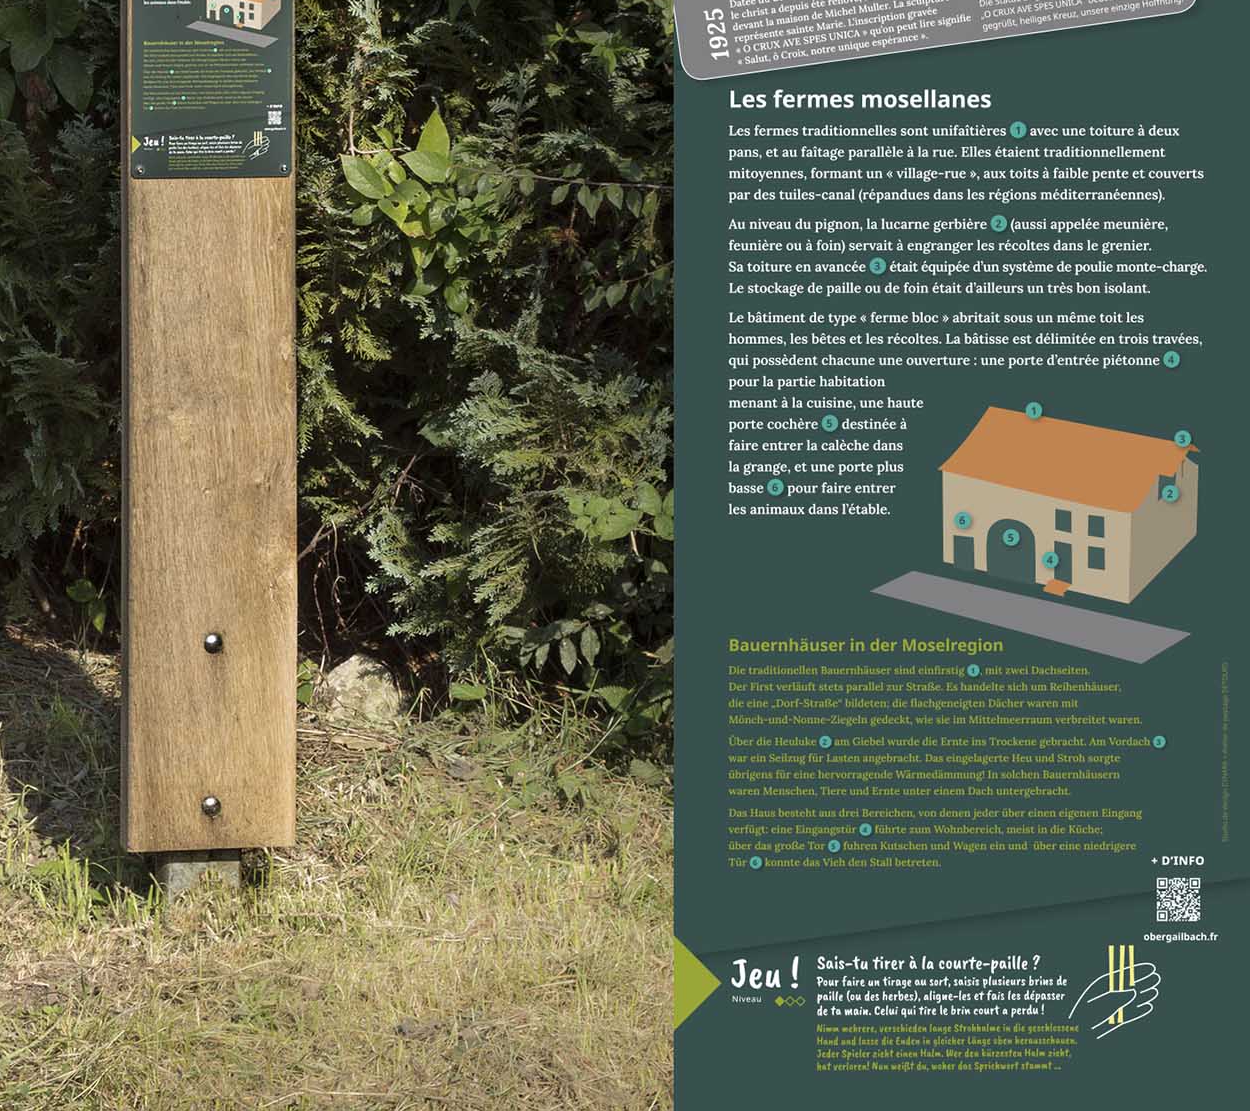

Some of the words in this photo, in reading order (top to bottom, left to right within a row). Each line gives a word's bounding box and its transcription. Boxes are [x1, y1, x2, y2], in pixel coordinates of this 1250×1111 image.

[704, 8, 729, 60] 1925
[730, 90, 767, 108] Les
[773, 89, 854, 108] fermes
[862, 89, 991, 108] mosellanes
[729, 125, 751, 136] Les
[754, 124, 799, 137] fermes
[802, 125, 897, 137] traditionnelles
[900, 126, 929, 137] sont
[932, 124, 1006, 137] unifaîtières
[1030, 128, 1058, 137] avec
[1062, 128, 1086, 136] une
[1089, 125, 1134, 136] toiture
[1138, 124, 1145, 136] à
[1148, 125, 1179, 136] deux
[143, 137, 159, 146] Jeu
[161, 135, 164, 146] !
[729, 503, 746, 515] les
[750, 504, 805, 515] animaux
[808, 503, 838, 515] dans
[842, 503, 890, 515] l’étable.
[729, 638, 845, 653] Bauernhäuser
[850, 638, 865, 652] in
[870, 638, 897, 652] der
[902, 638, 1003, 654] Moselregion
[728, 788, 759, 796] waren
[850, 786, 869, 796] und
[872, 787, 900, 796] Ernte
[903, 787, 930, 796] unter
[933, 787, 964, 796] einem
[968, 786, 994, 796] Dach
[1162, 856, 1204, 865] D'INFO
[1144, 932, 1218, 943] obergailbach.fr
[817, 956, 868, 970] Sais-tu
[872, 956, 905, 970] tirer
[909, 955, 917, 969] à
[922, 956, 934, 970] la
[939, 955, 1028, 973] courte-paille
[731, 959, 781, 989] Jeu
[816, 976, 839, 987] Pour
[842, 975, 865, 987] faire
[883, 976, 912, 989] tirage
[929, 976, 951, 987] sort,
[954, 976, 979, 986] saisis
[982, 976, 1026, 988] plusieurs
[1029, 975, 1054, 986] brins
[1056, 975, 1067, 986] de
[732, 995, 762, 1003] Niveau
